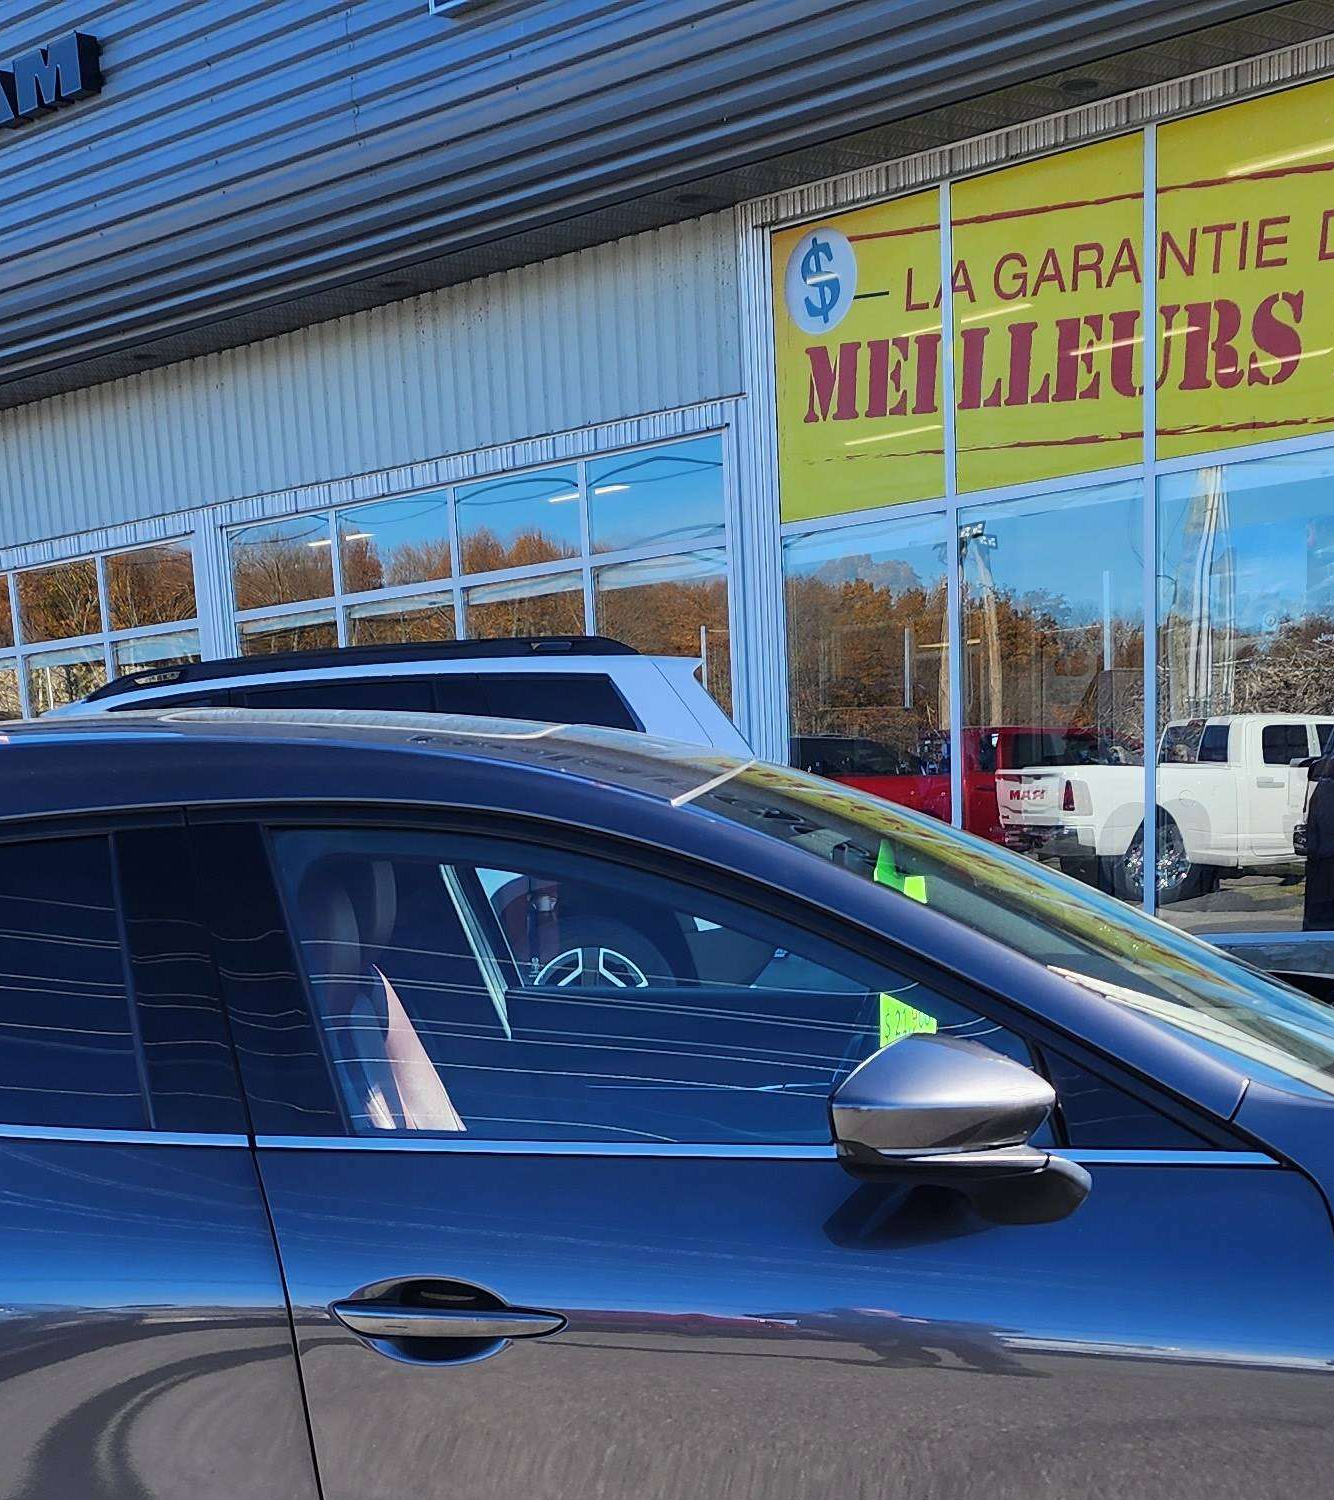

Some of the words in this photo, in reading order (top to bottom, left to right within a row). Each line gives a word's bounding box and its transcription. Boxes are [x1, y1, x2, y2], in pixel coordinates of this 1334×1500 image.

[906, 257, 975, 312] LA
[994, 216, 1289, 301] GARANTIE
[803, 290, 1304, 424] MEILLEURS
